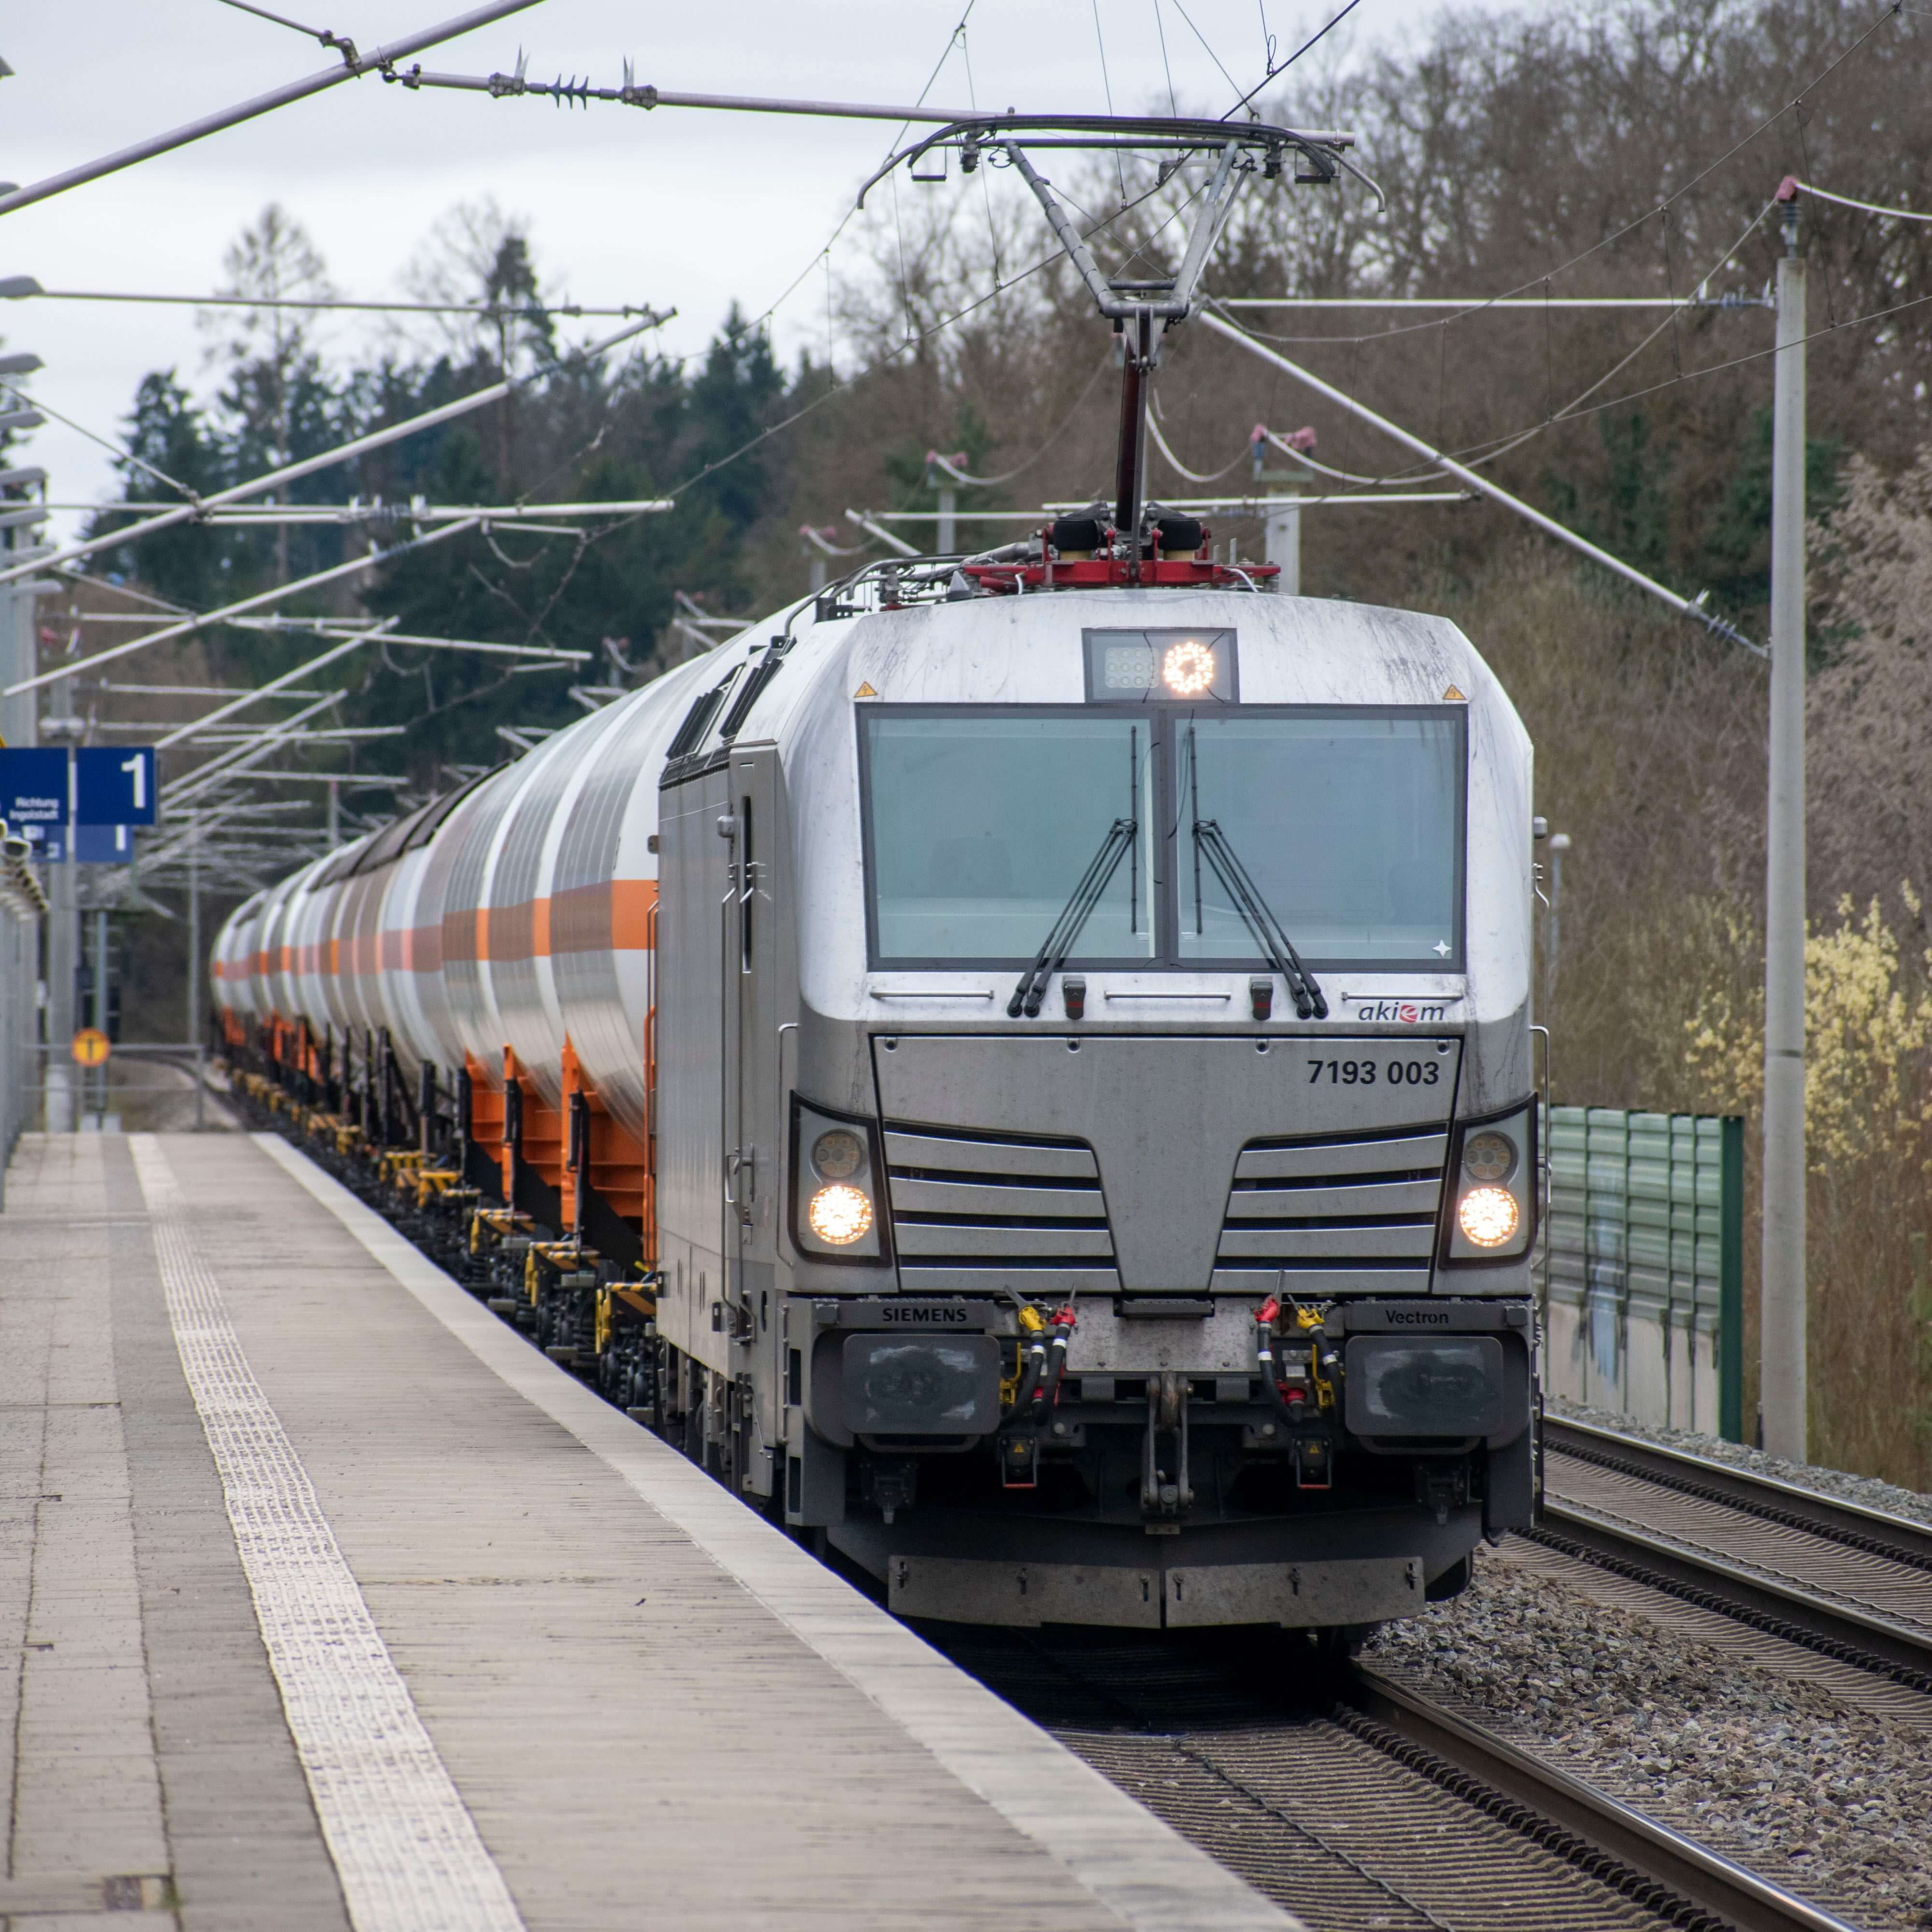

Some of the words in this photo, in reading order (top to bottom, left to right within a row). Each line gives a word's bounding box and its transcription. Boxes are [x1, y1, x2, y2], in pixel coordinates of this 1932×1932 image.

[122, 753, 145, 809] 1
[1358, 1001, 1444, 1023] akiem
[1307, 1060, 1376, 1084] 7193
[1387, 1061, 1439, 1085] 003
[882, 1308, 967, 1322] SIEMENS
[1385, 1310, 1449, 1324] Vectron
